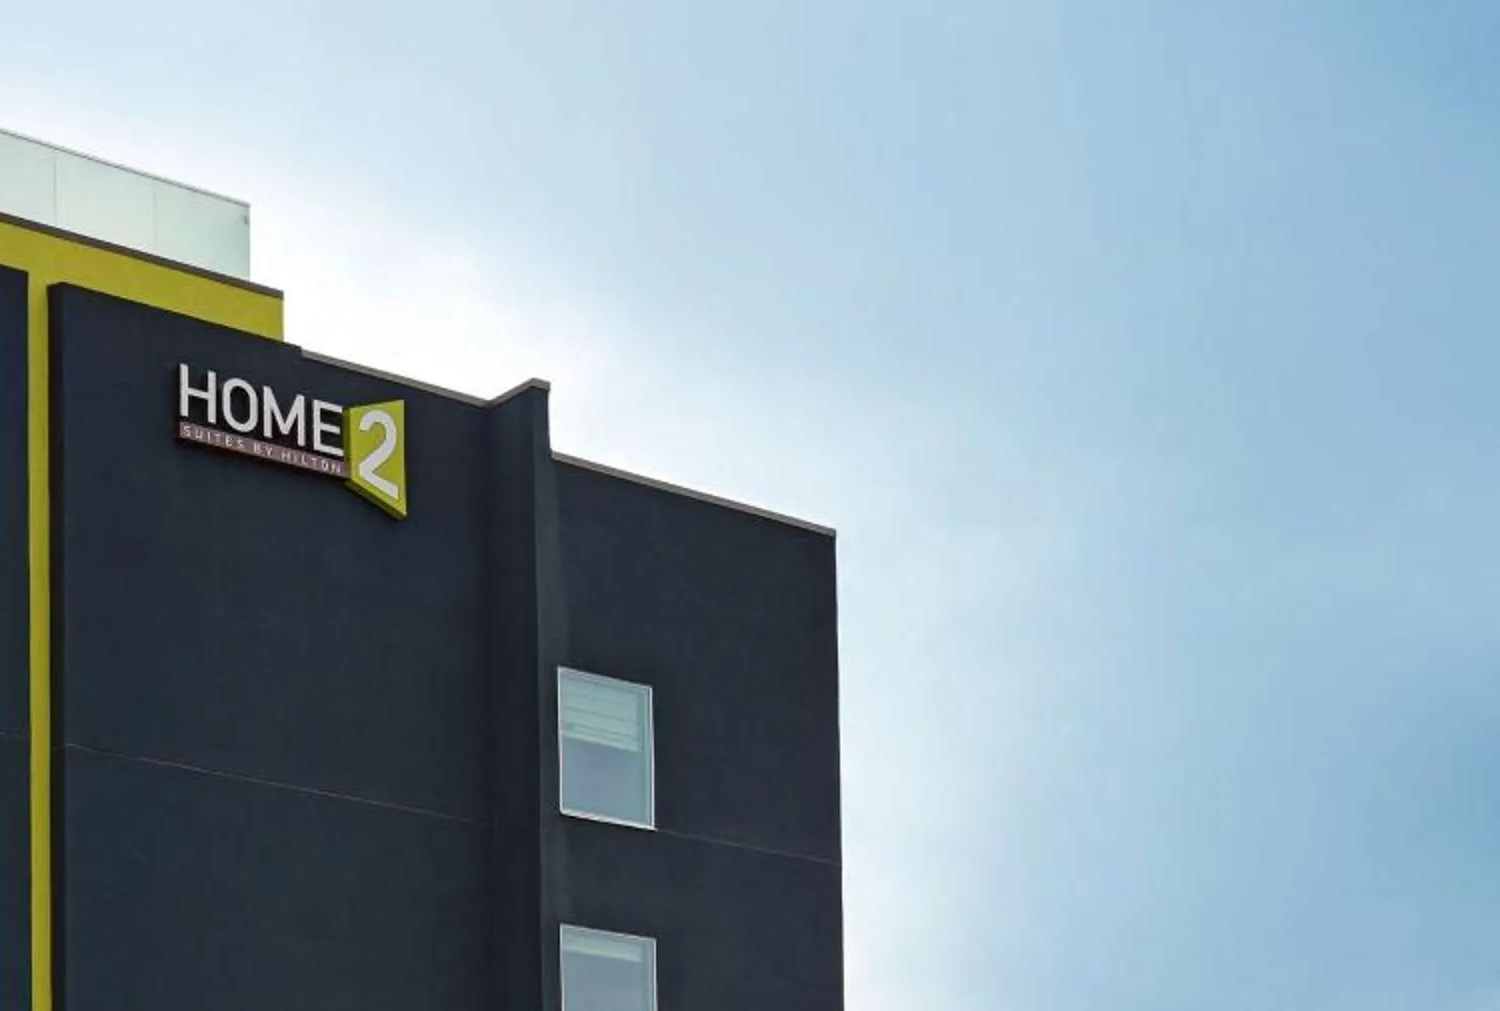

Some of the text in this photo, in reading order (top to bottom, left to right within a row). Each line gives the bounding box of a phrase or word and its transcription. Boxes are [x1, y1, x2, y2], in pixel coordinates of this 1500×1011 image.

[182, 425, 342, 475] SUITES BY HILTON
